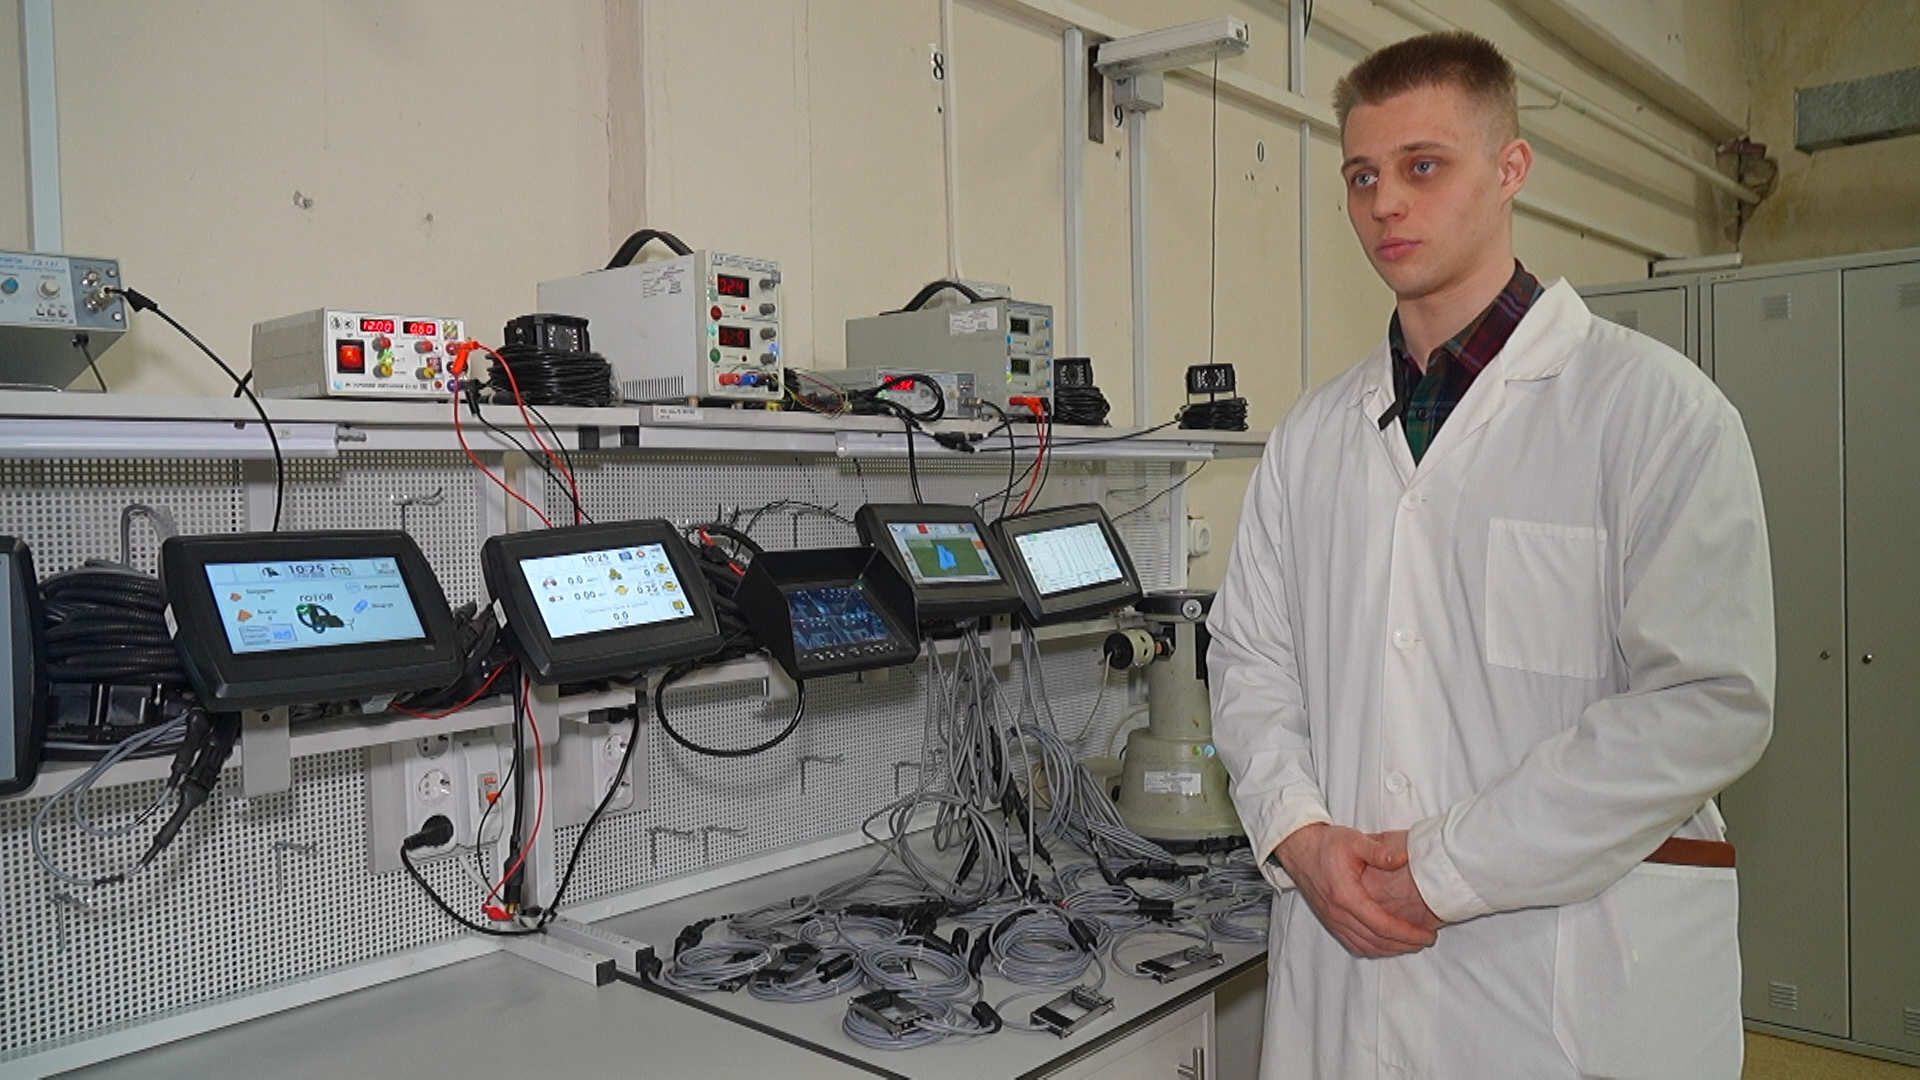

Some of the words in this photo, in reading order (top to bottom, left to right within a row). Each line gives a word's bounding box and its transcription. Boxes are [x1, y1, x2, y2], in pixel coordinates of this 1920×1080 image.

[933, 51, 944, 80] 8
[1113, 105, 1123, 128] 9
[1257, 141, 1264, 162] 0
[288, 564, 325, 575] 10:25
[299, 593, 334, 603] ГОТОВ
